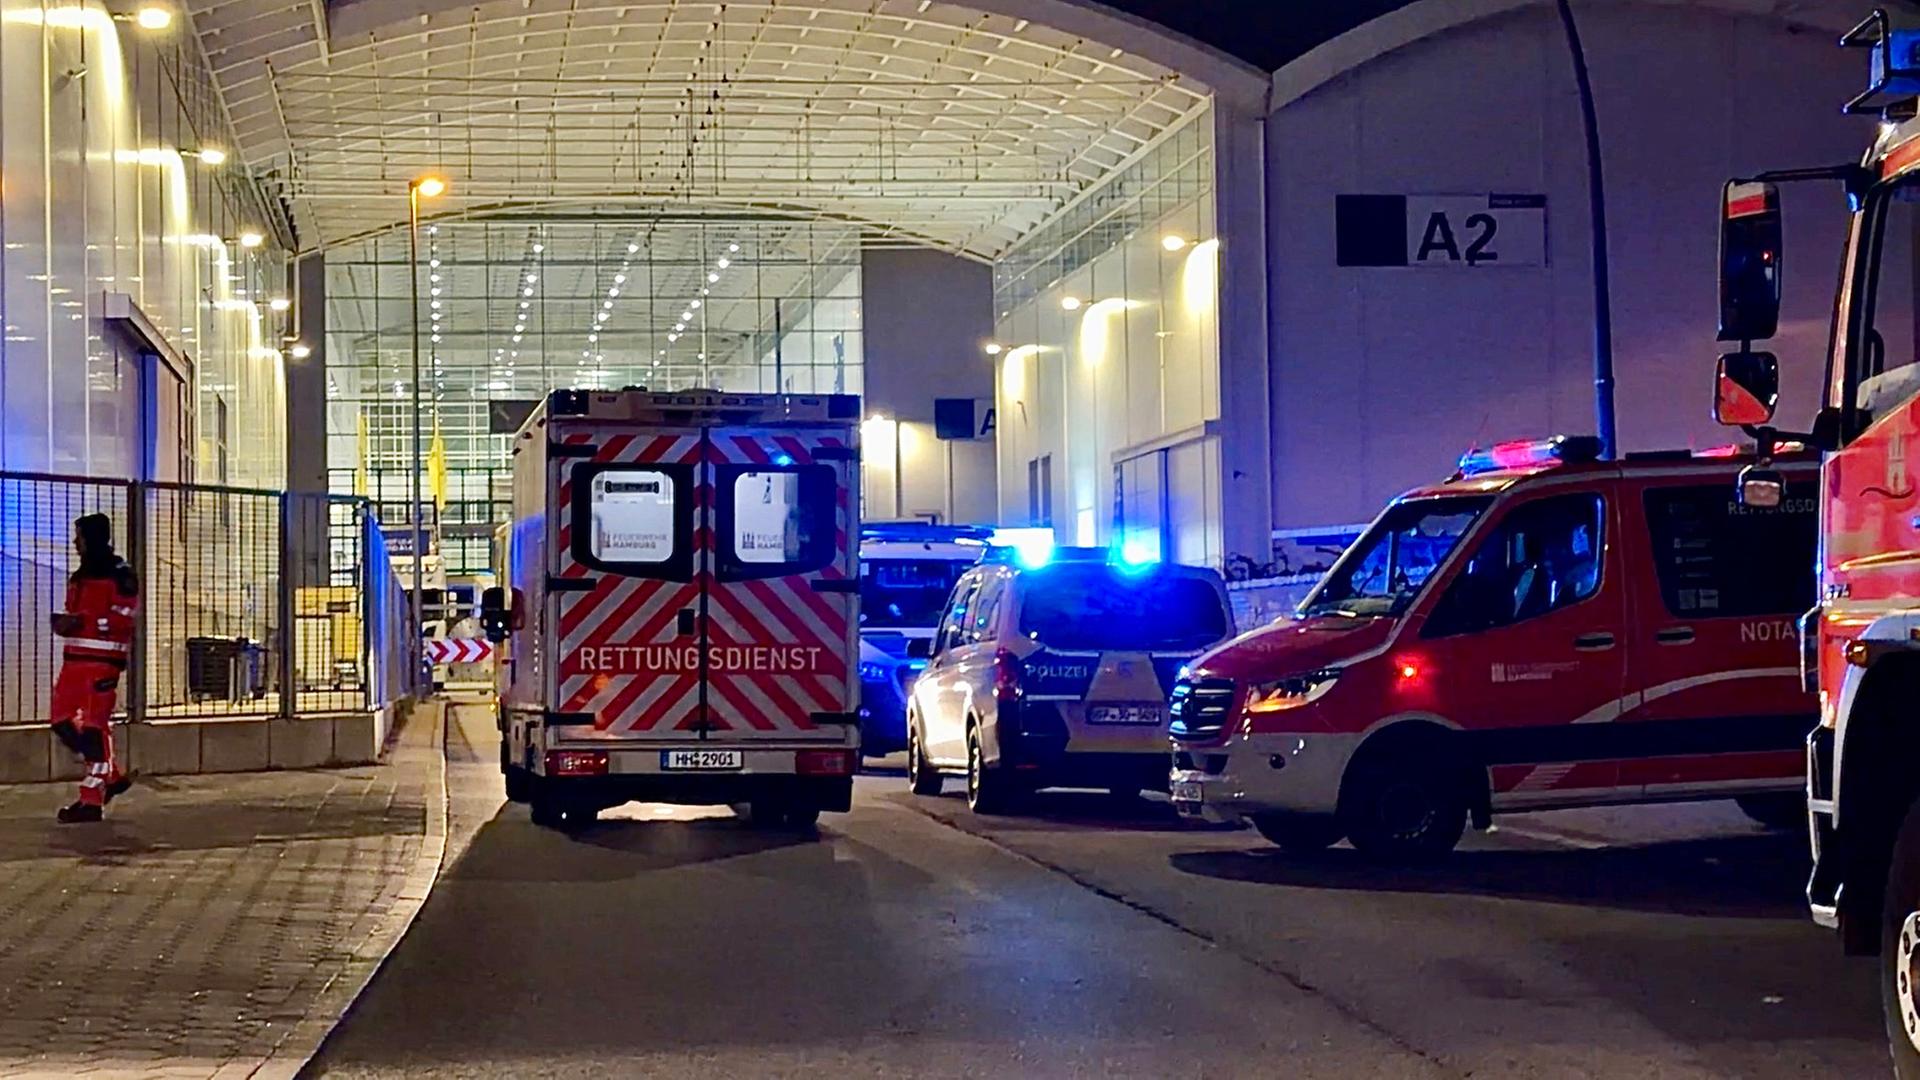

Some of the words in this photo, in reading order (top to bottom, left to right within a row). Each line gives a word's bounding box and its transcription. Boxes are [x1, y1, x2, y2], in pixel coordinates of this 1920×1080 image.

[1417, 211, 1498, 263] A2
[1026, 664, 1088, 679] POLIZEI
[702, 752, 734, 766] 2901
